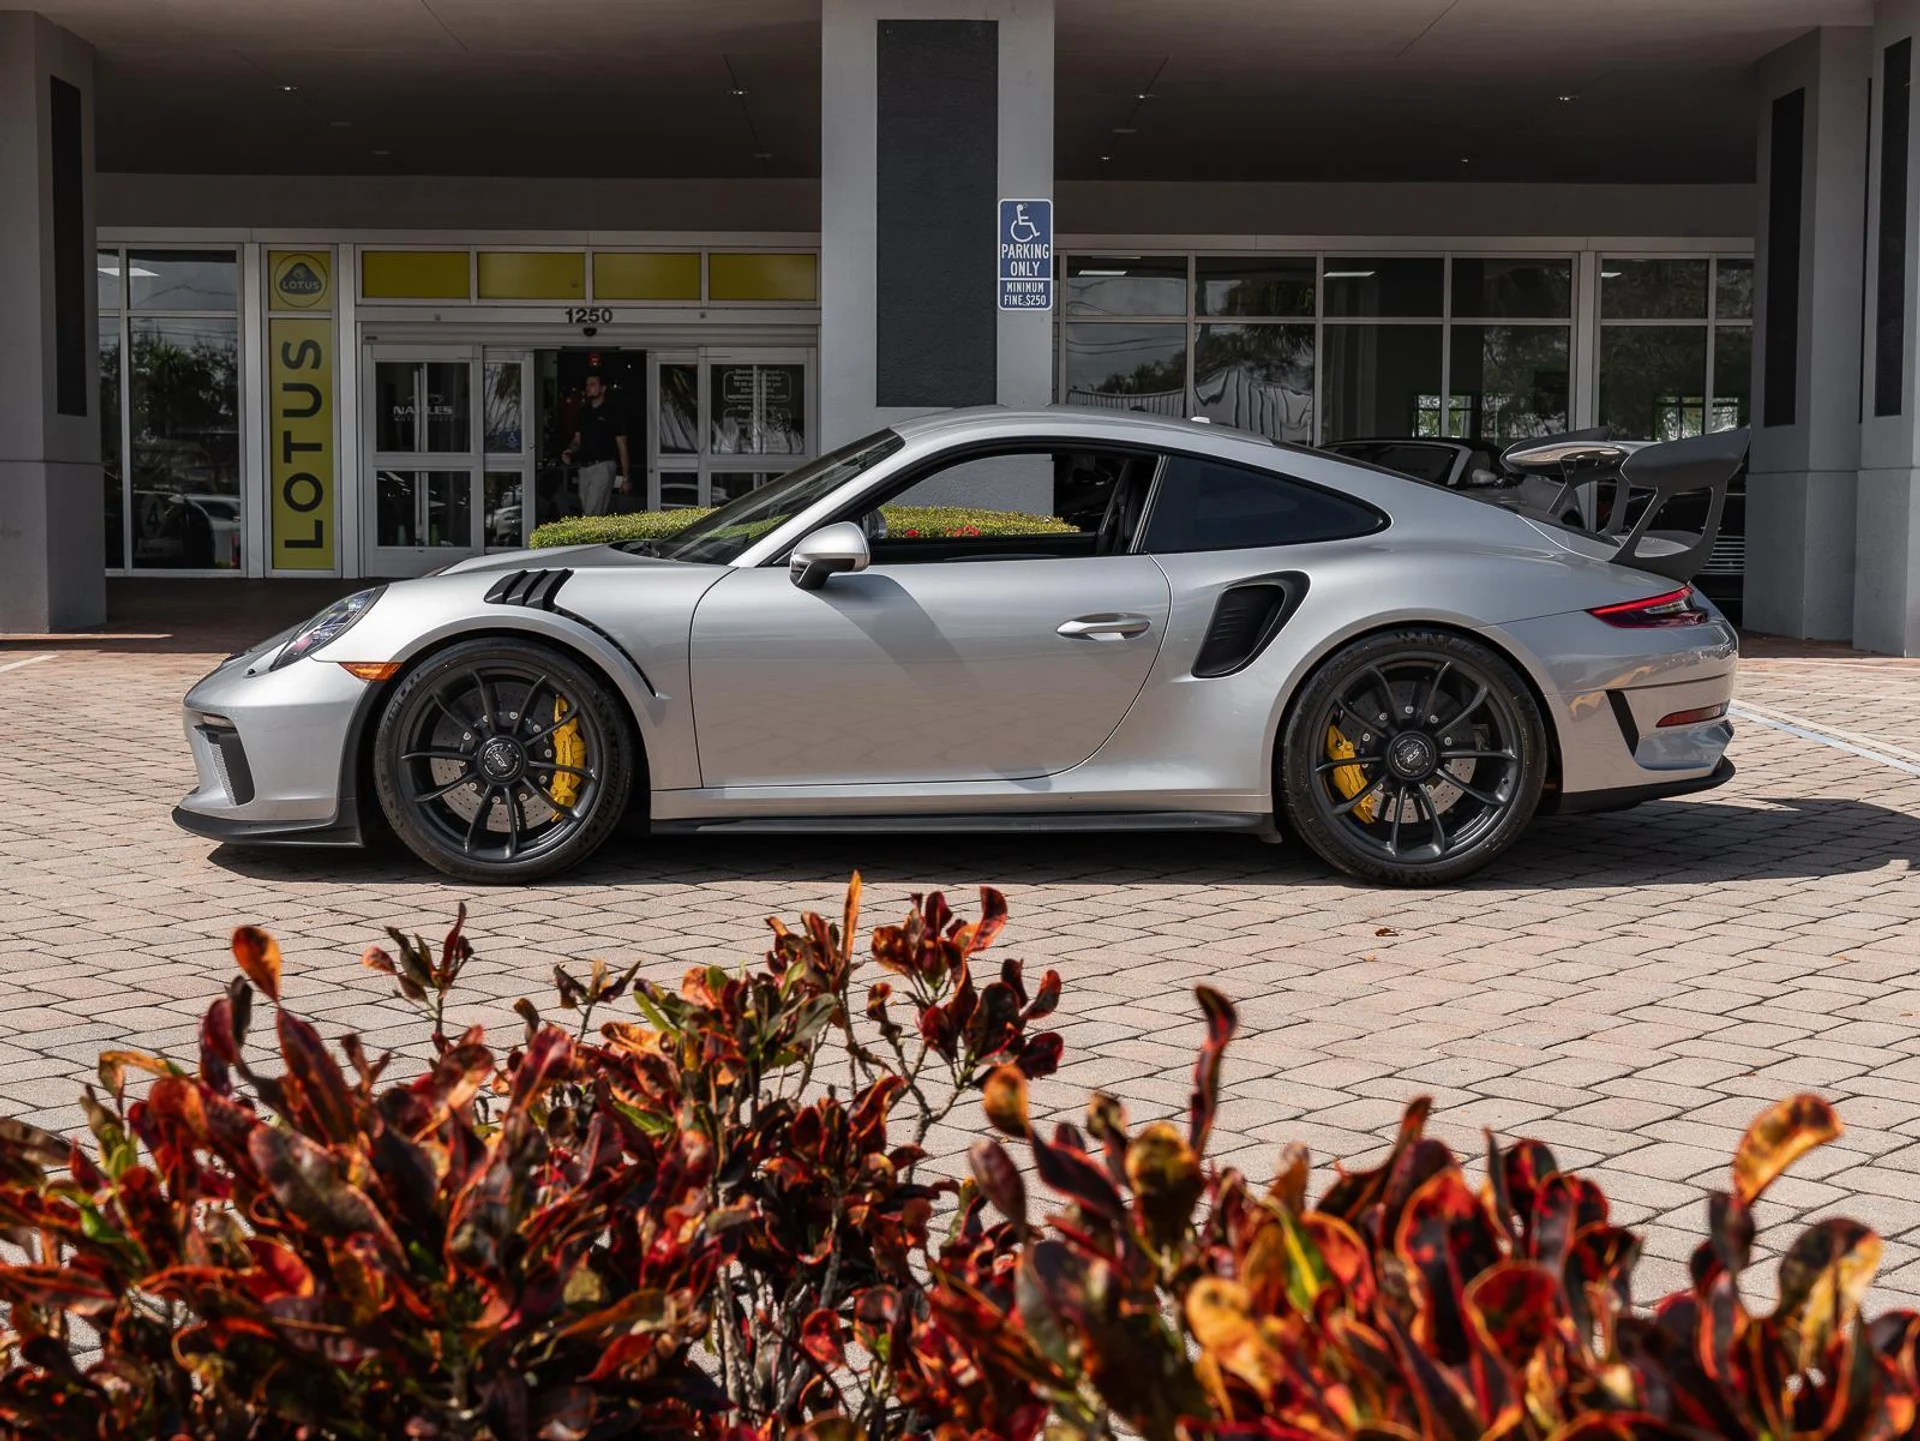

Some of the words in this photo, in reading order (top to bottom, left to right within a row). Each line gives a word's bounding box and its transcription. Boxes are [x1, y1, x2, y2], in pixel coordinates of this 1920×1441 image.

[1001, 243, 1049, 259] PARKING
[1010, 261, 1040, 277] ONLY
[282, 280, 320, 290] LOTUS
[1006, 282, 1044, 293] MINIMUM
[1004, 295, 1024, 306] FINE
[1025, 294, 1047, 306] $250
[565, 308, 613, 323] 1250
[281, 339, 323, 548] LOTUS
